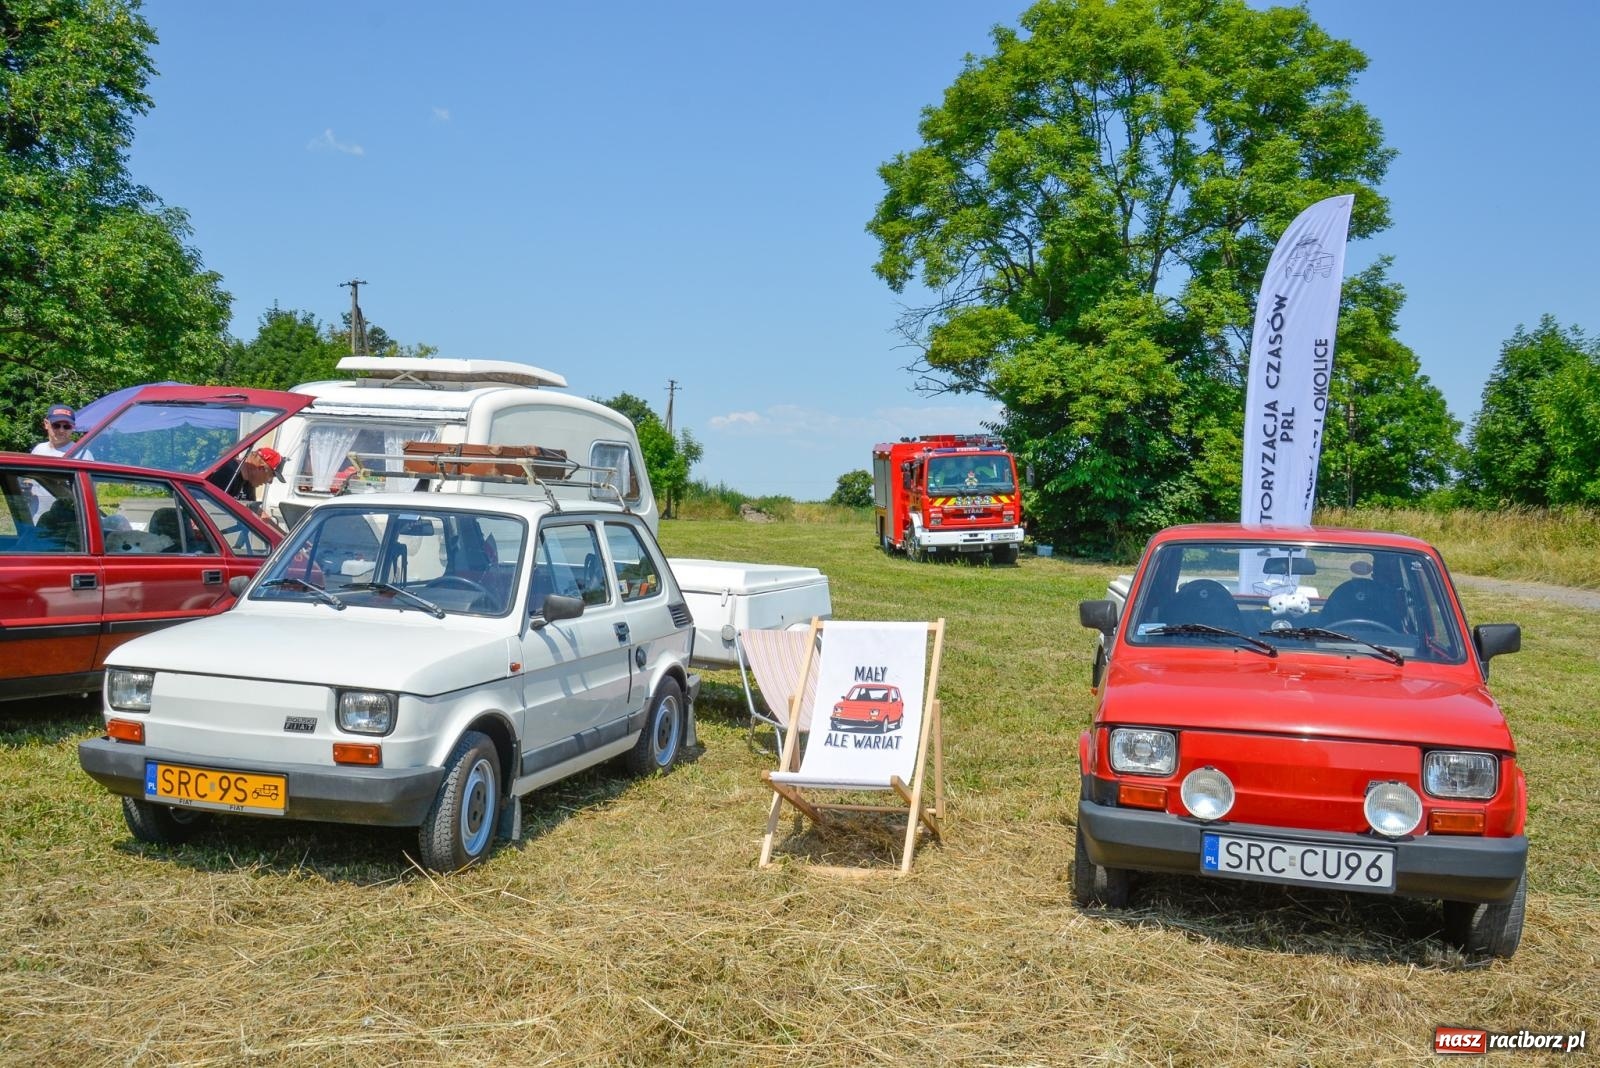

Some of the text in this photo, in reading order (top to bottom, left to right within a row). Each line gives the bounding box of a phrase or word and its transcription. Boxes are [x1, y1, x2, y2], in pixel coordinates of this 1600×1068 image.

[1313, 339, 1328, 412] OKOLICE
[1259, 294, 1288, 524] TORYZACJA CZASÓW
[1280, 407, 1295, 442] PRL
[854, 666, 887, 682] MAŁY
[285, 722, 314, 731] FIAT
[824, 733, 902, 749] ALE WARIAT
[148, 782, 156, 790] PL
[162, 769, 248, 803] SRC 9S
[1205, 856, 1216, 865] PL
[1225, 841, 1384, 883] SRC CU96
